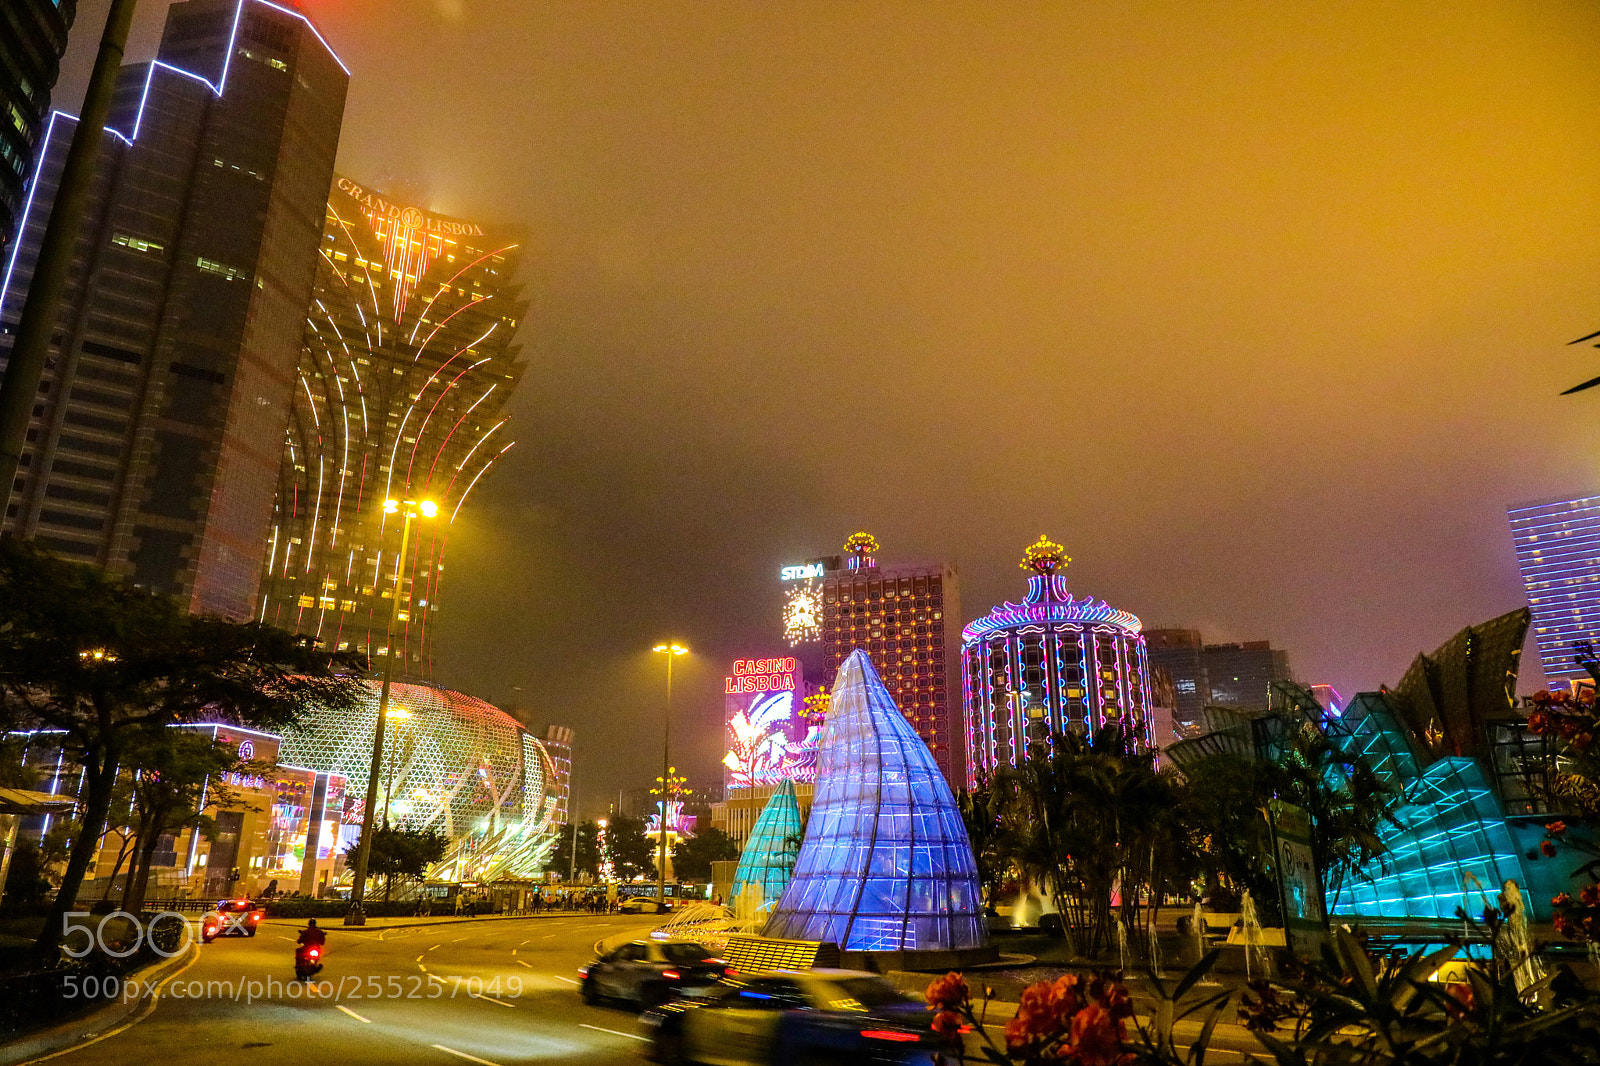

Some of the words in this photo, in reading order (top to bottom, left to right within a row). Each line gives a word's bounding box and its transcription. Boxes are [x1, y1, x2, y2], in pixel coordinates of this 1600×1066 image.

[337, 177, 401, 219] GRAND
[426, 217, 485, 237] LISBOA
[733, 657, 796, 676] CASINO
[725, 673, 796, 694] LISBOA
